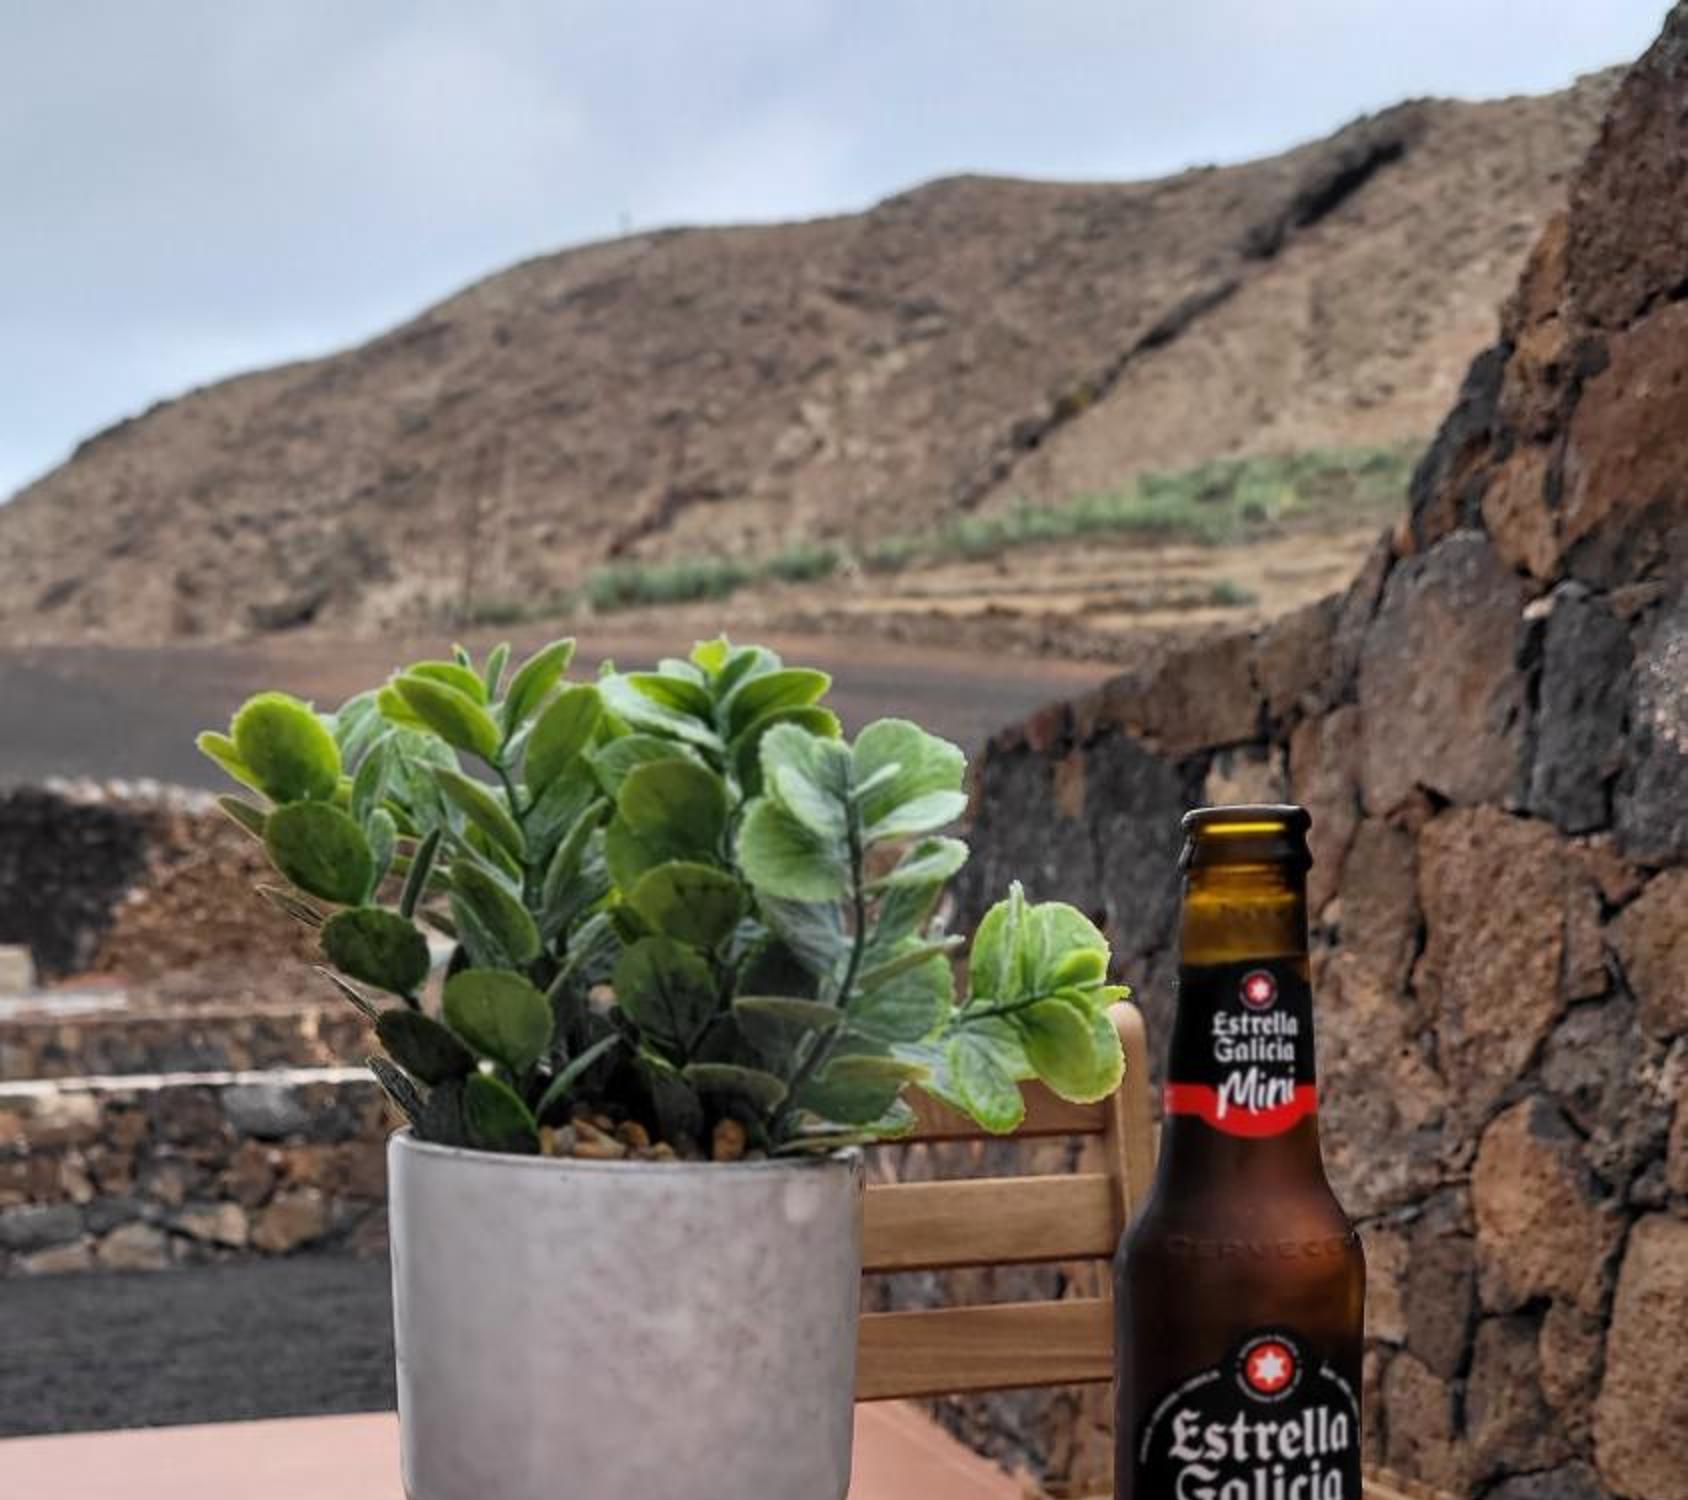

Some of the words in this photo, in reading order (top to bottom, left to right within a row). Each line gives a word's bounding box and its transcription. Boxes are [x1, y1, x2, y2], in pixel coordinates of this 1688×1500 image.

[1212, 1011, 1299, 1036] Estrella
[1214, 1036, 1295, 1063] Galicia
[1216, 1066, 1296, 1120] Mini
[1168, 1406, 1348, 1462] Estrella
